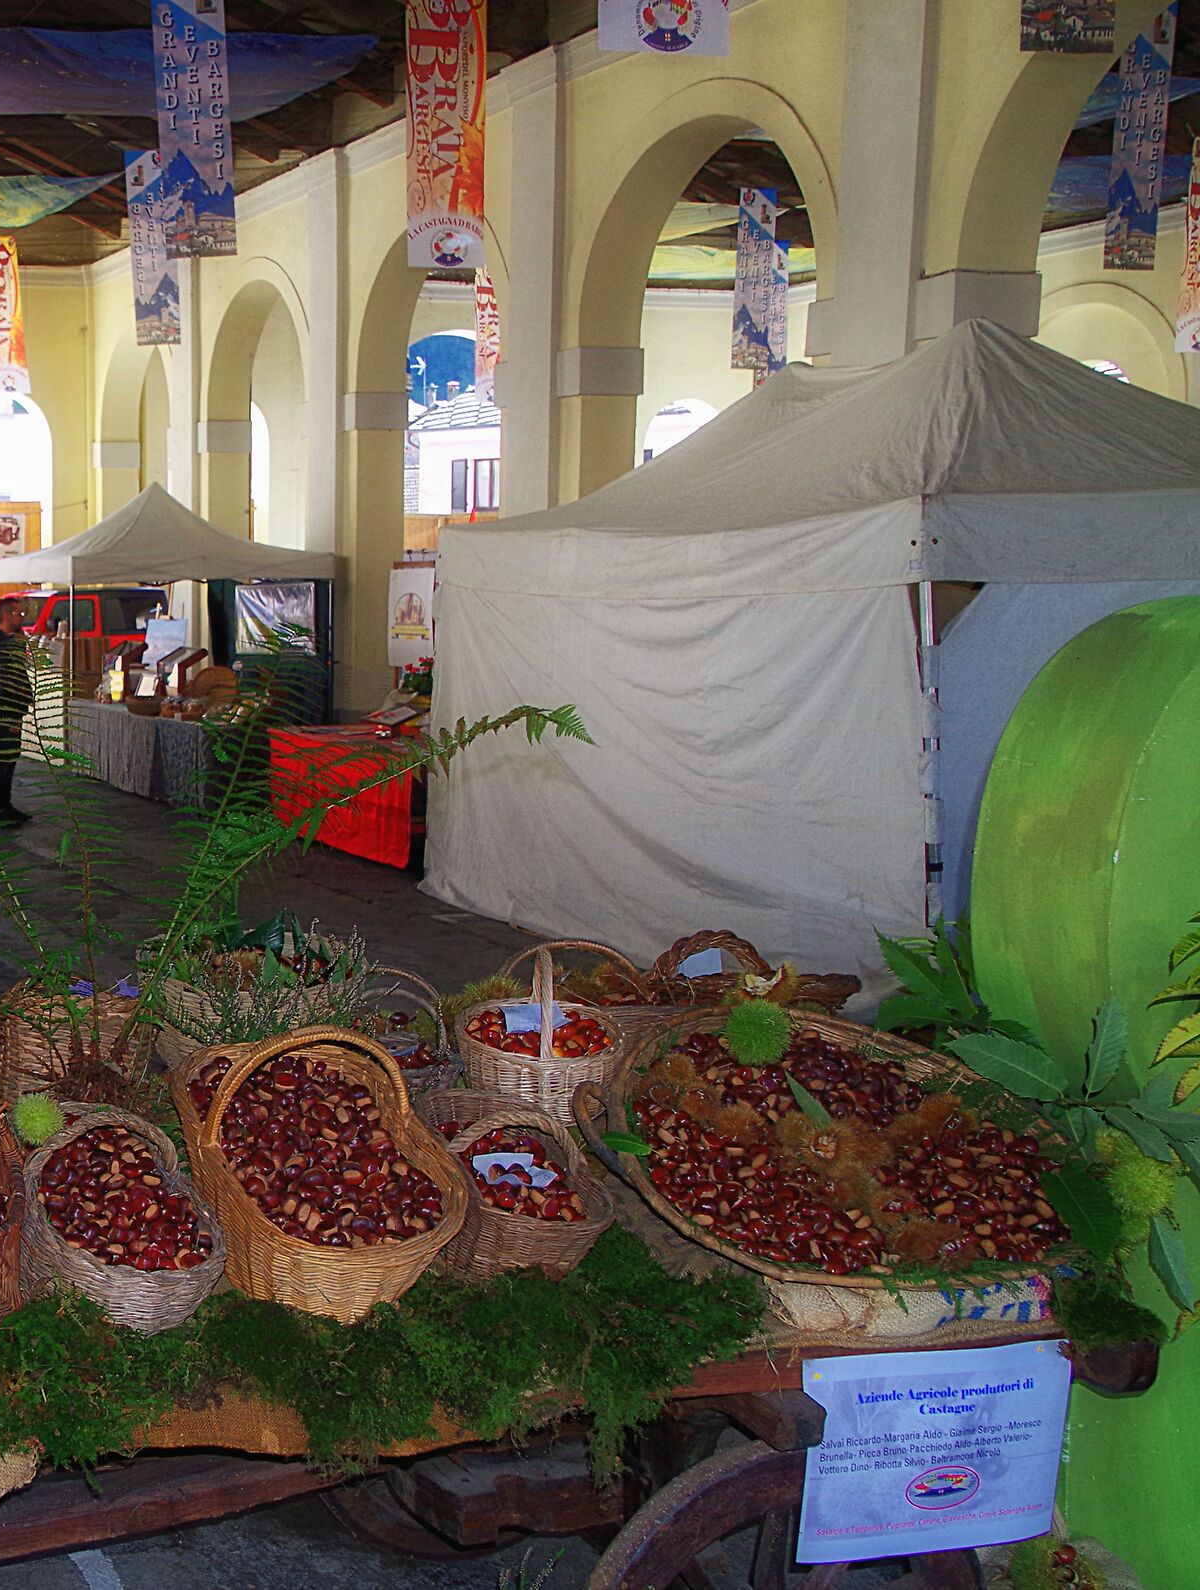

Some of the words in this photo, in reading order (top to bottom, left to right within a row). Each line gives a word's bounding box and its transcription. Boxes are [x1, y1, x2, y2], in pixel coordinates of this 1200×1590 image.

[160, 11, 178, 130] GRANDI
[183, 25, 201, 145] EVENTI
[206, 40, 225, 180] BARGESI
[1135, 54, 1152, 166] EVENTI
[1147, 69, 1167, 199] BARGESI
[739, 218, 750, 292] GRANDI
[751, 229, 760, 302] EVENTI
[761, 240, 772, 324] BARGESI
[857, 1391, 904, 1405] Aziende
[907, 1386, 959, 1402] Agricole
[961, 1380, 1021, 1400] produttori
[1023, 1378, 1034, 1389] di
[919, 1403, 976, 1414] Castagne
[819, 1465, 849, 1475] Vottero
[874, 1459, 902, 1470] Ribotta
[931, 1452, 975, 1465] Beltramone
[820, 1438, 845, 1450] Salvai
[922, 1430, 943, 1440] Aldo
[977, 1423, 1003, 1435] Sergio
[859, 1448, 881, 1459] Picca
